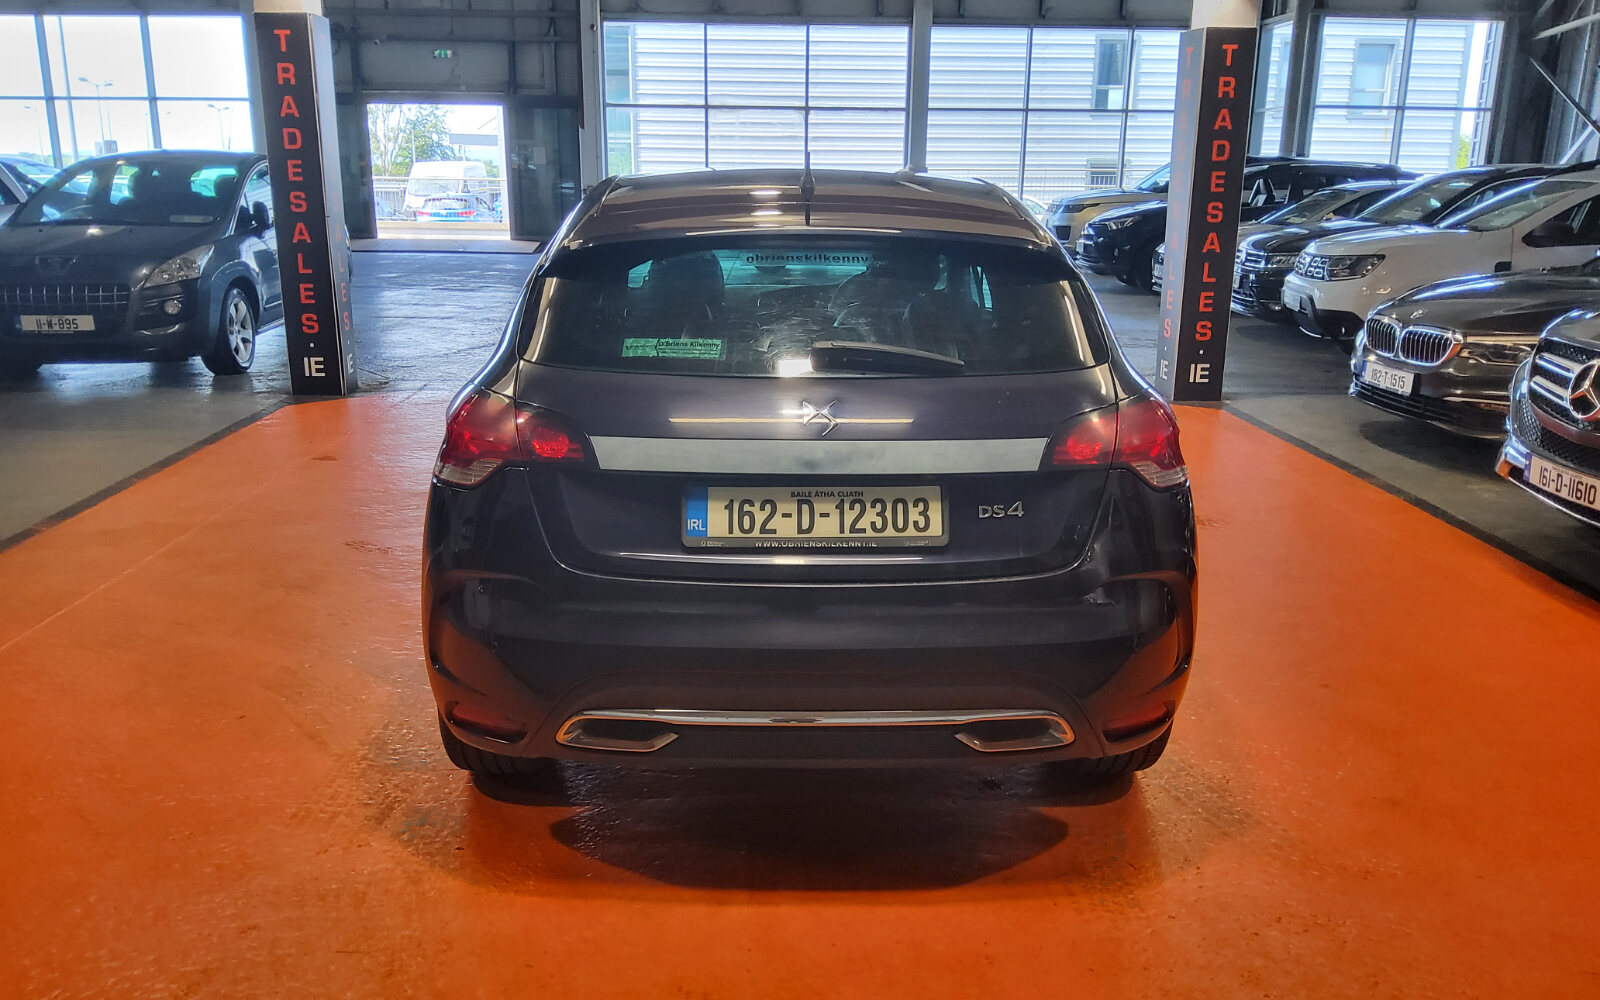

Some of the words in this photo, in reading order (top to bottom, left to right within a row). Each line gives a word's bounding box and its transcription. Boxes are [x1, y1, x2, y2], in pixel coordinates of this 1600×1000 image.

[36, 318, 79, 330] 11-W-895
[1370, 367, 1406, 389] 182-T-1515
[814, 490, 835, 498] ÁTHA
[1539, 465, 1597, 505] 161-D-11610
[723, 498, 931, 535] 162-D-12303
[978, 500, 1025, 518] DS4
[687, 519, 706, 531] IRL
